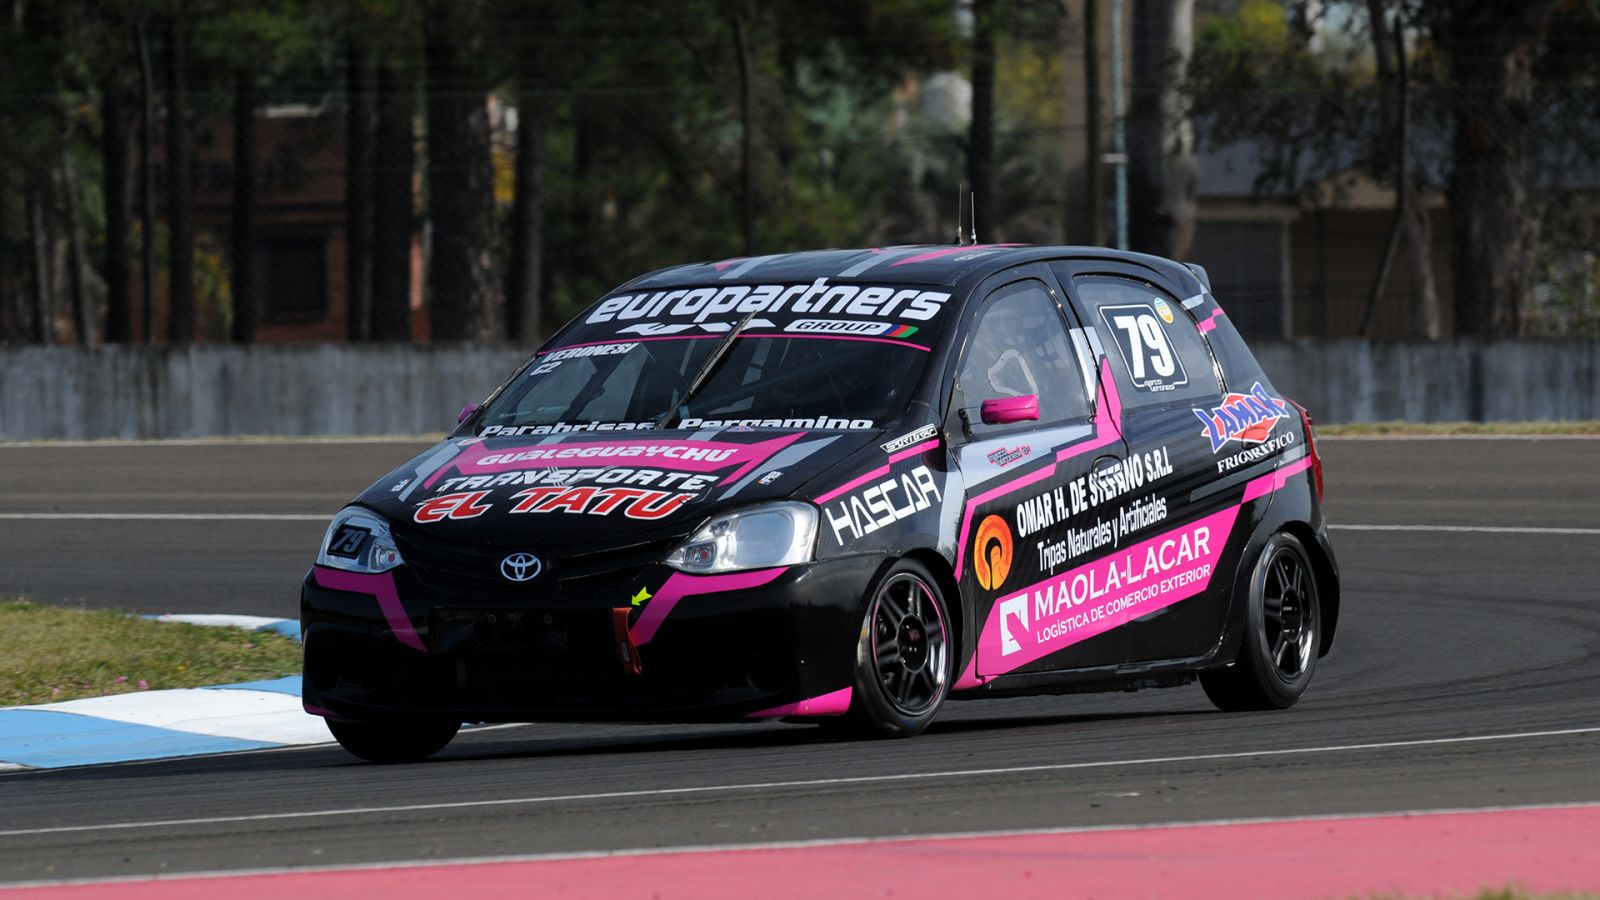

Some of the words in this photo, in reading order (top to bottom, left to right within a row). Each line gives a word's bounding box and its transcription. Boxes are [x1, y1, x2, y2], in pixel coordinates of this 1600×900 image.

[585, 277, 951, 325] europartners
[796, 321, 881, 333] GROUP
[530, 361, 562, 376] C2
[541, 342, 639, 363] VERONESI
[1113, 314, 1175, 378] 79
[1192, 382, 1290, 454] LAMAR
[413, 489, 494, 524] EL
[508, 486, 700, 520] TATU
[436, 466, 720, 491] TRANSPORTE
[825, 465, 942, 546] HASCAR
[1016, 493, 1054, 538] OMAR
[1054, 486, 1070, 522] H.
[1069, 477, 1089, 516] DE
[1089, 452, 1144, 507] STEFANO
[1144, 446, 1174, 483] S.R.L
[330, 528, 367, 554] 79
[1037, 538, 1067, 575] Tripas
[1067, 516, 1112, 560] Naturales
[1112, 515, 1118, 548] y
[1119, 492, 1168, 537] Artificiales
[1034, 526, 1211, 622] MAOLA-LACAR
[1037, 612, 1090, 644] LOGÍSTICA
[1091, 605, 1105, 622] DE
[1106, 583, 1159, 616] COMERCIO
[1160, 564, 1211, 594] EXTERIOR
